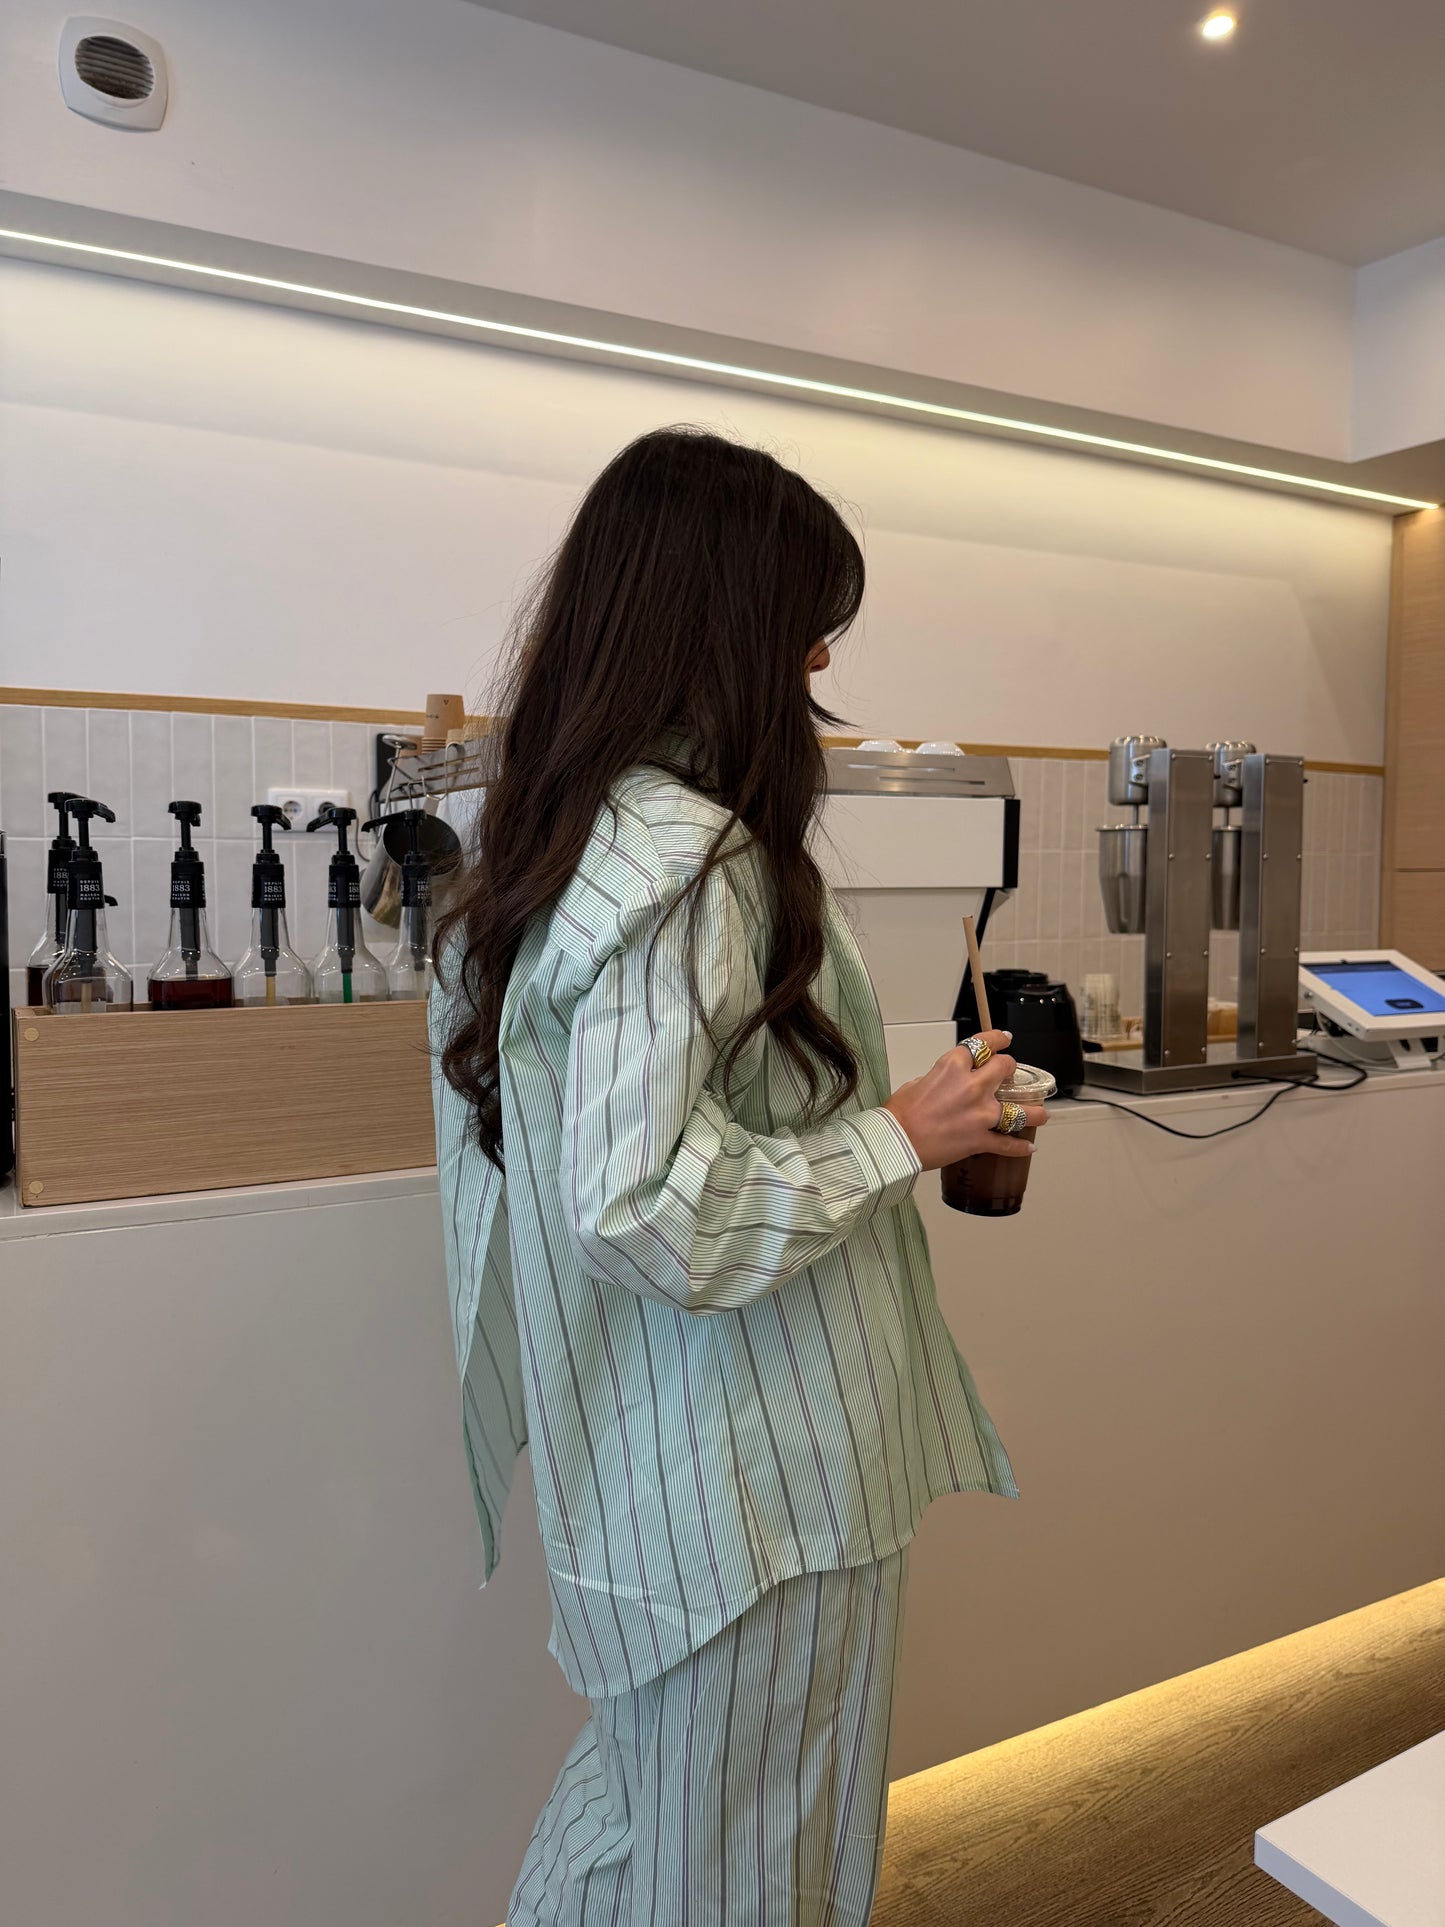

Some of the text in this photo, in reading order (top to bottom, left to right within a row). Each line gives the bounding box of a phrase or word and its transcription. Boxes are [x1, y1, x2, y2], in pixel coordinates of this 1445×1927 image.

[53, 871, 69, 879] 188
[80, 884, 100, 892] 1883
[172, 884, 190, 892] 1883
[264, 885, 283, 893] 1883
